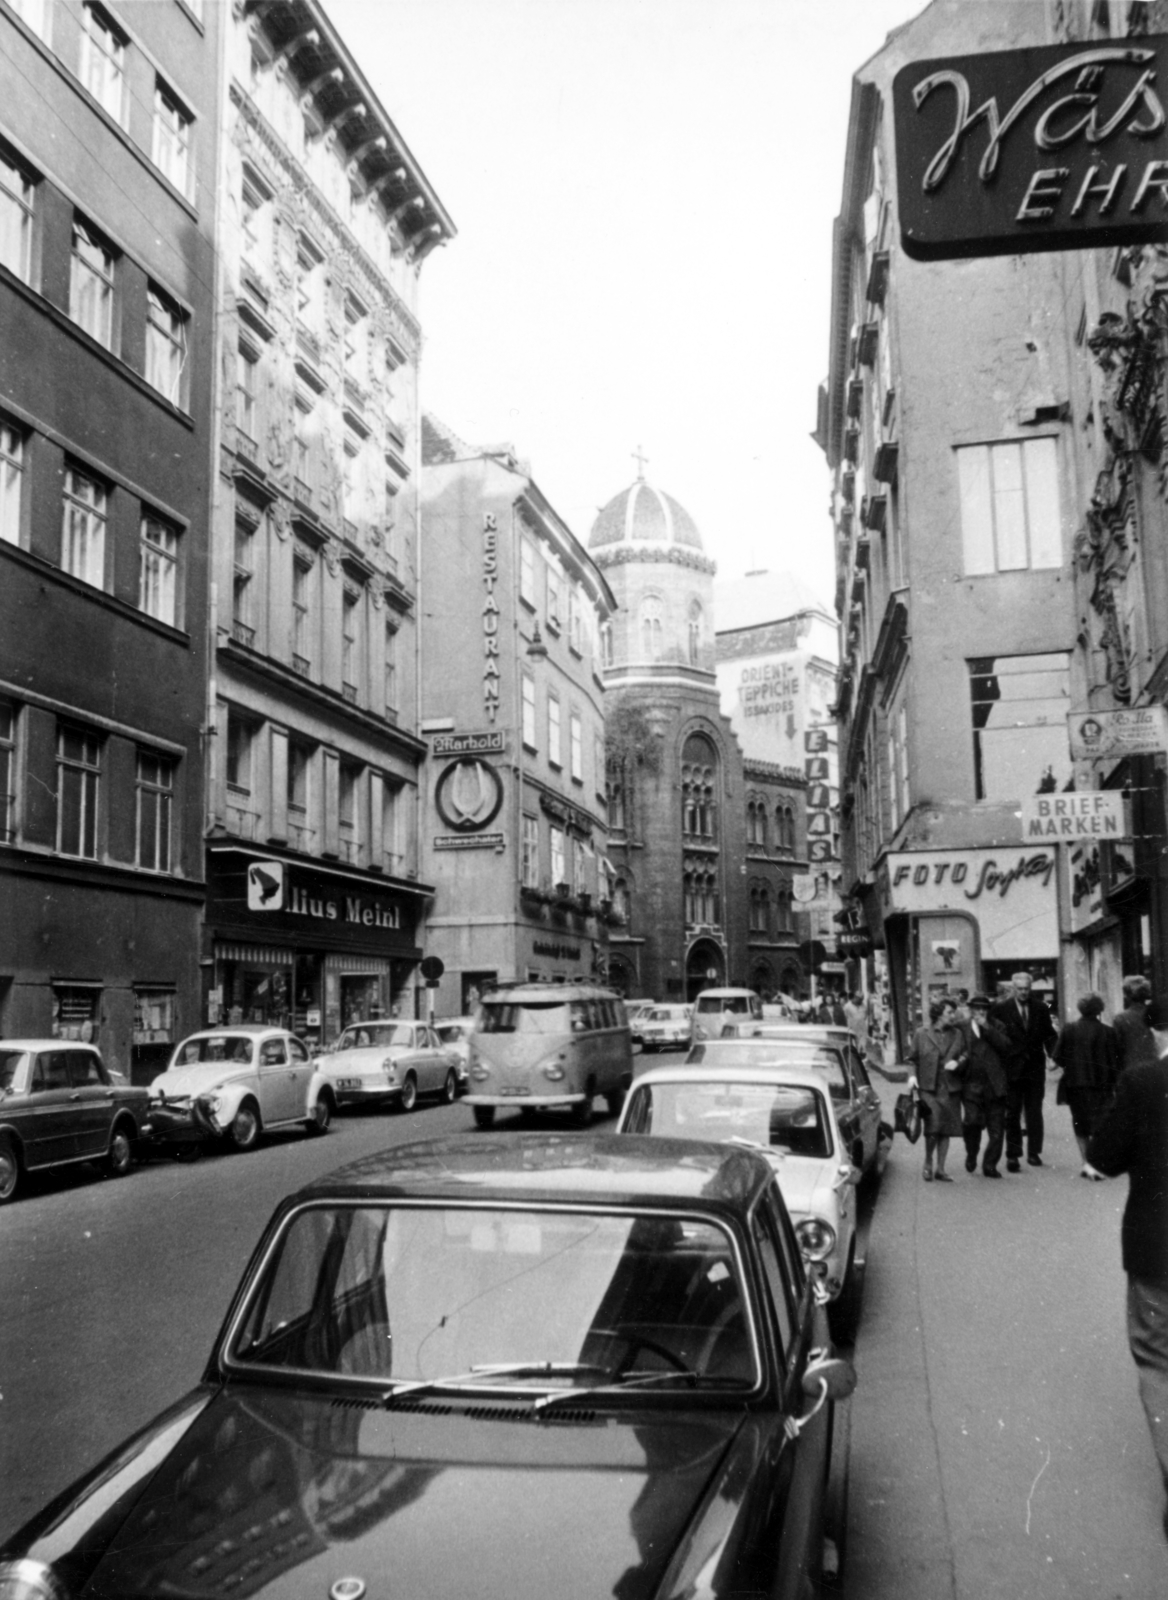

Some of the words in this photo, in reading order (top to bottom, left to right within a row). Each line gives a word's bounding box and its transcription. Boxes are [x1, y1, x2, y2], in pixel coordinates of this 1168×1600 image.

[484, 512, 500, 723] RESTAURANT
[741, 662, 794, 683] ORIENT-
[737, 678, 799, 702] TEPPICHE
[809, 732, 829, 860] ELIAS
[1038, 796, 1109, 818] BRIEF-
[1029, 814, 1117, 836] MARKEN
[893, 862, 968, 886] FOTO
[285, 886, 337, 920] lius
[346, 897, 400, 929] Meinl
